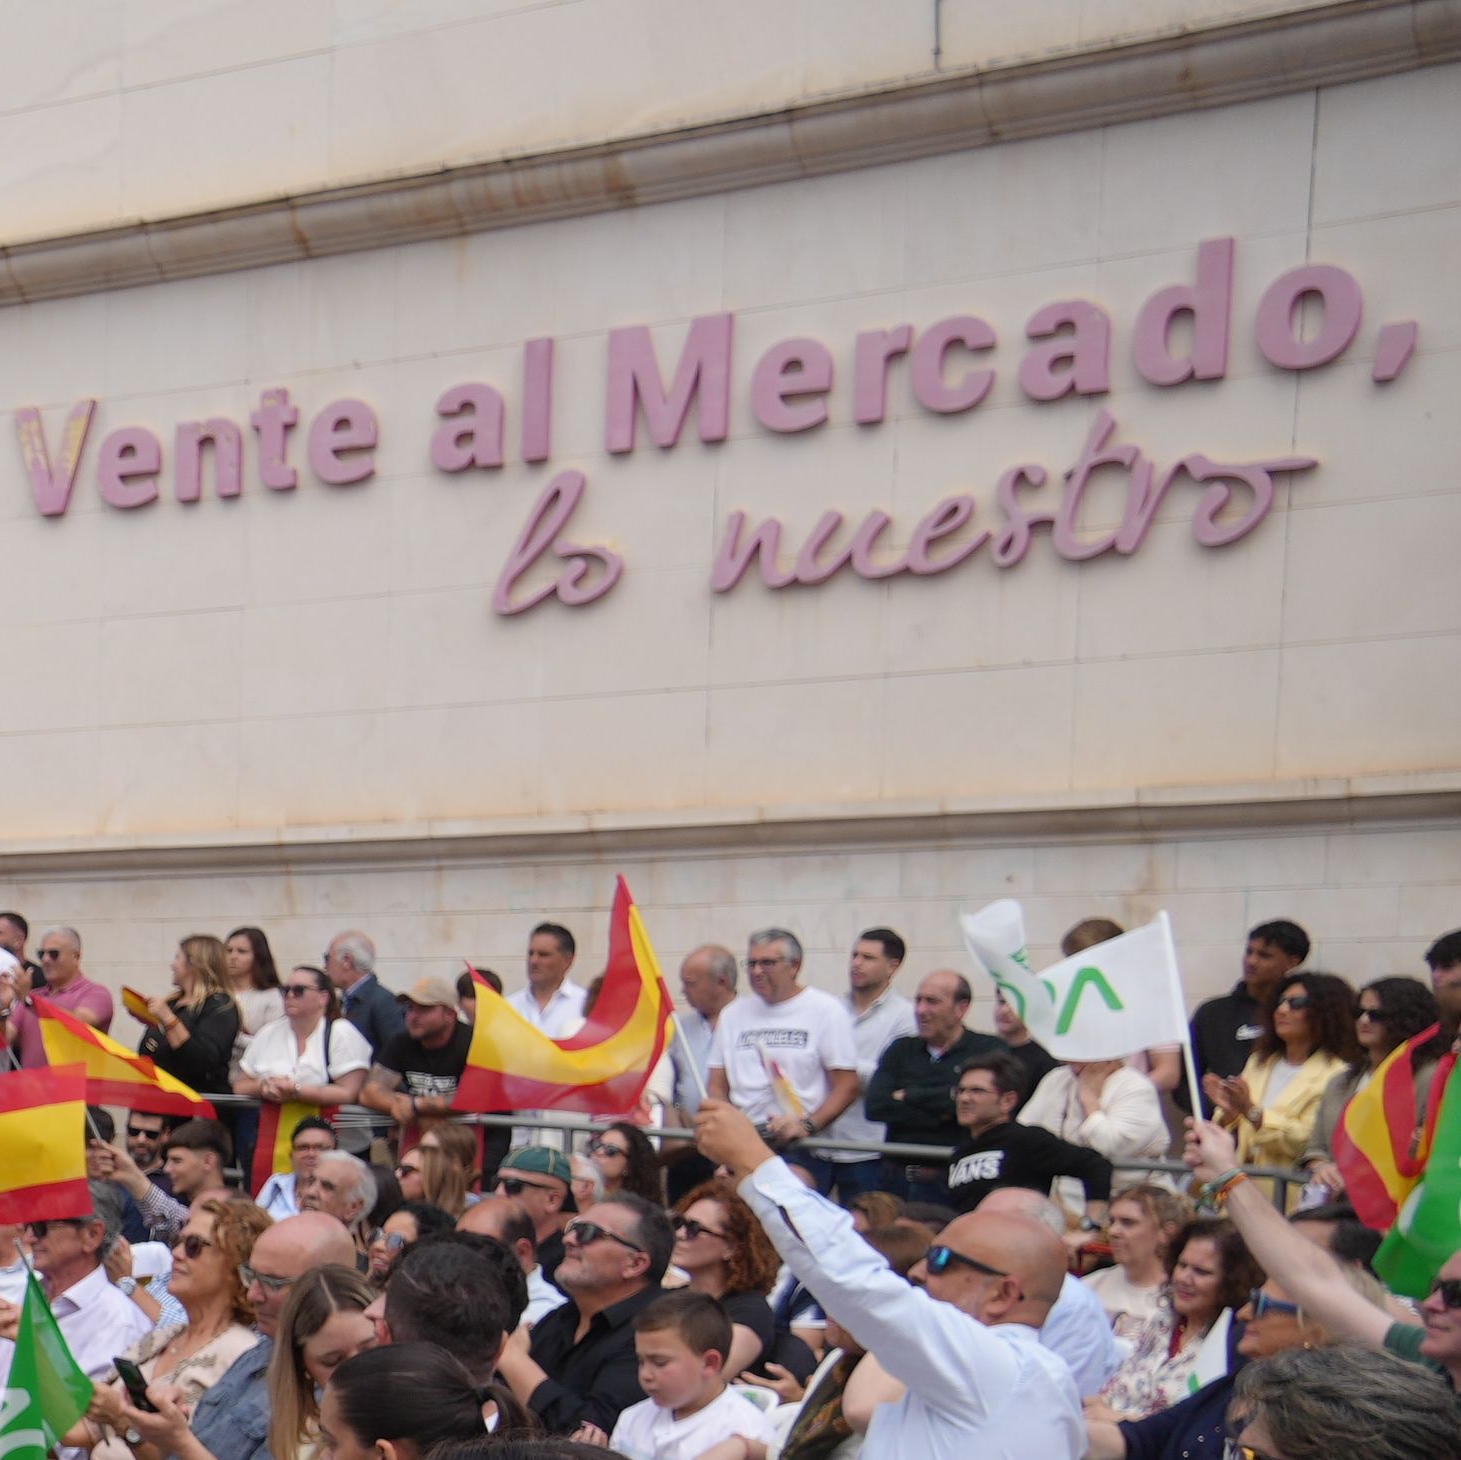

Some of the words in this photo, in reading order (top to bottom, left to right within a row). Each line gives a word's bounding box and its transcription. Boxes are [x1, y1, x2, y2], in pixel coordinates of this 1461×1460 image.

[13, 386, 380, 519] Vente
[430, 335, 556, 472] al
[604, 236, 1420, 456] Mercado,
[492, 469, 625, 617] lo
[709, 407, 1321, 594] nuestro
[948, 1150, 1004, 1188] VANS
